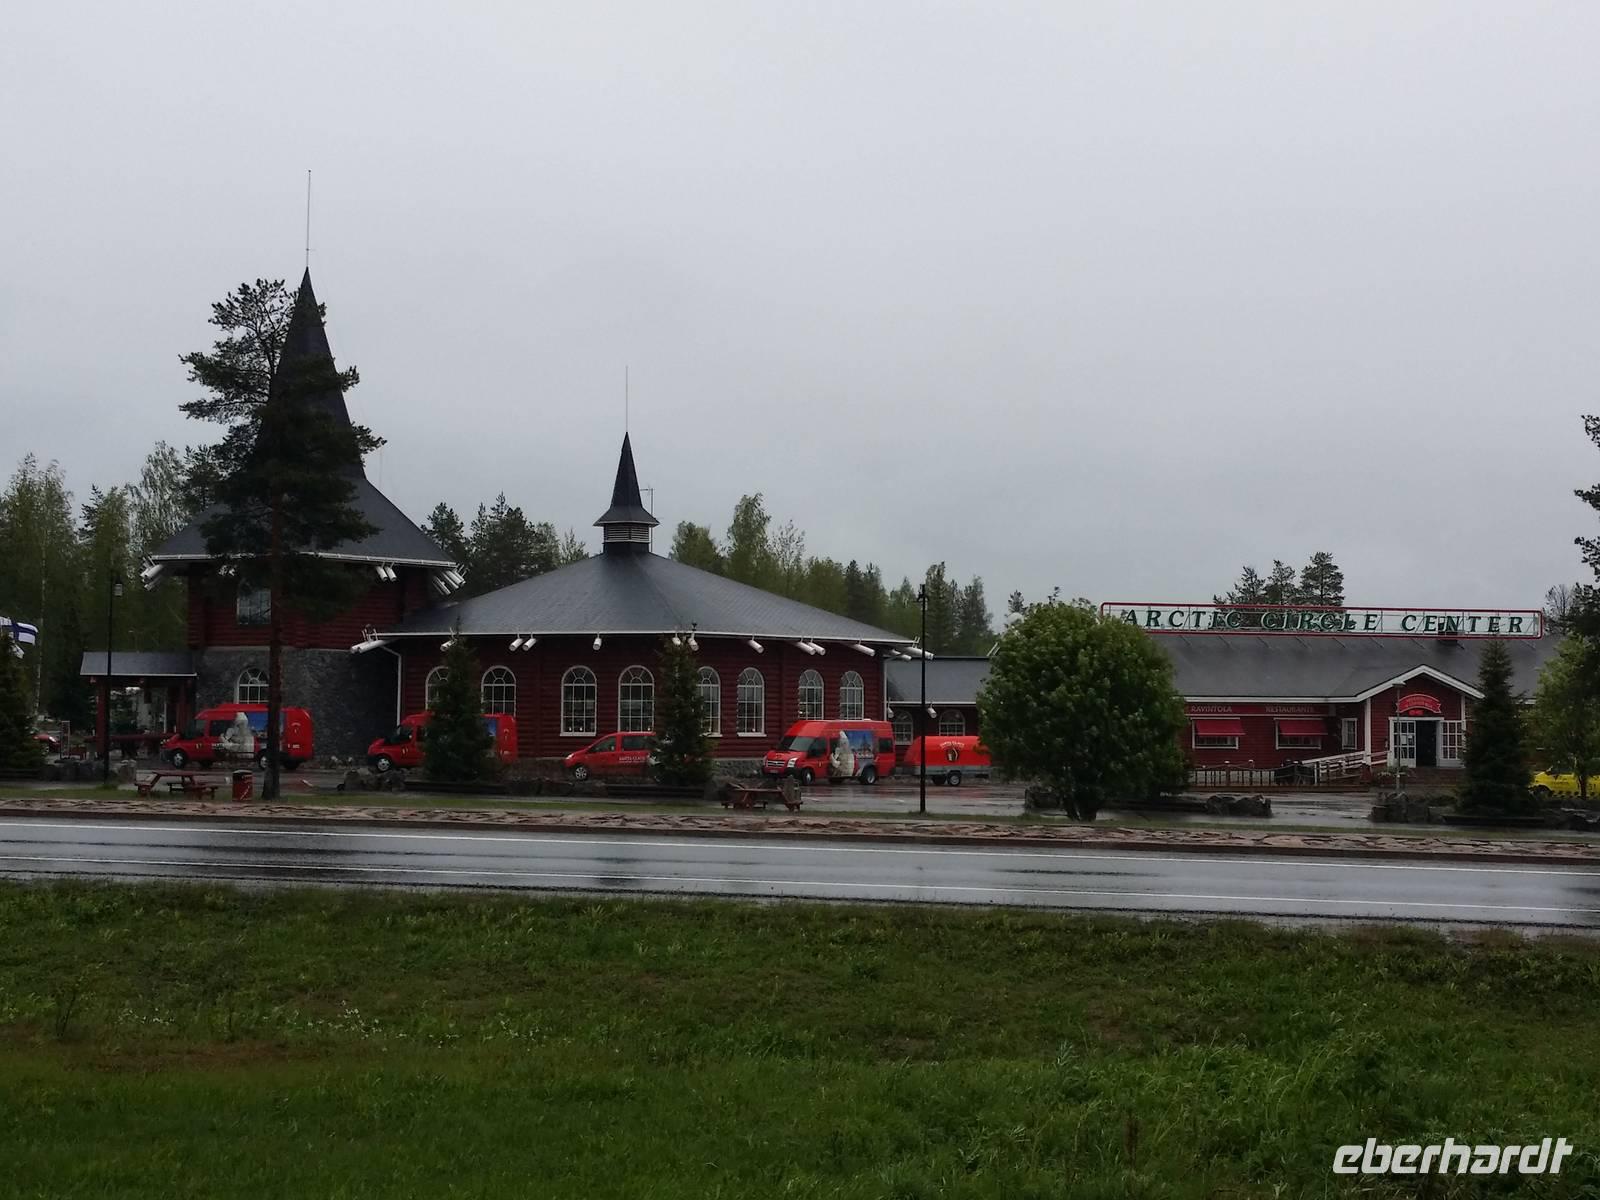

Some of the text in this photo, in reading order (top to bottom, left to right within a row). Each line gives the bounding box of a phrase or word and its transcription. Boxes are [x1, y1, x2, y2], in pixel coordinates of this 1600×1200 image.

[1125, 608, 1525, 634] ARCTIC CIRCLE CENTER
